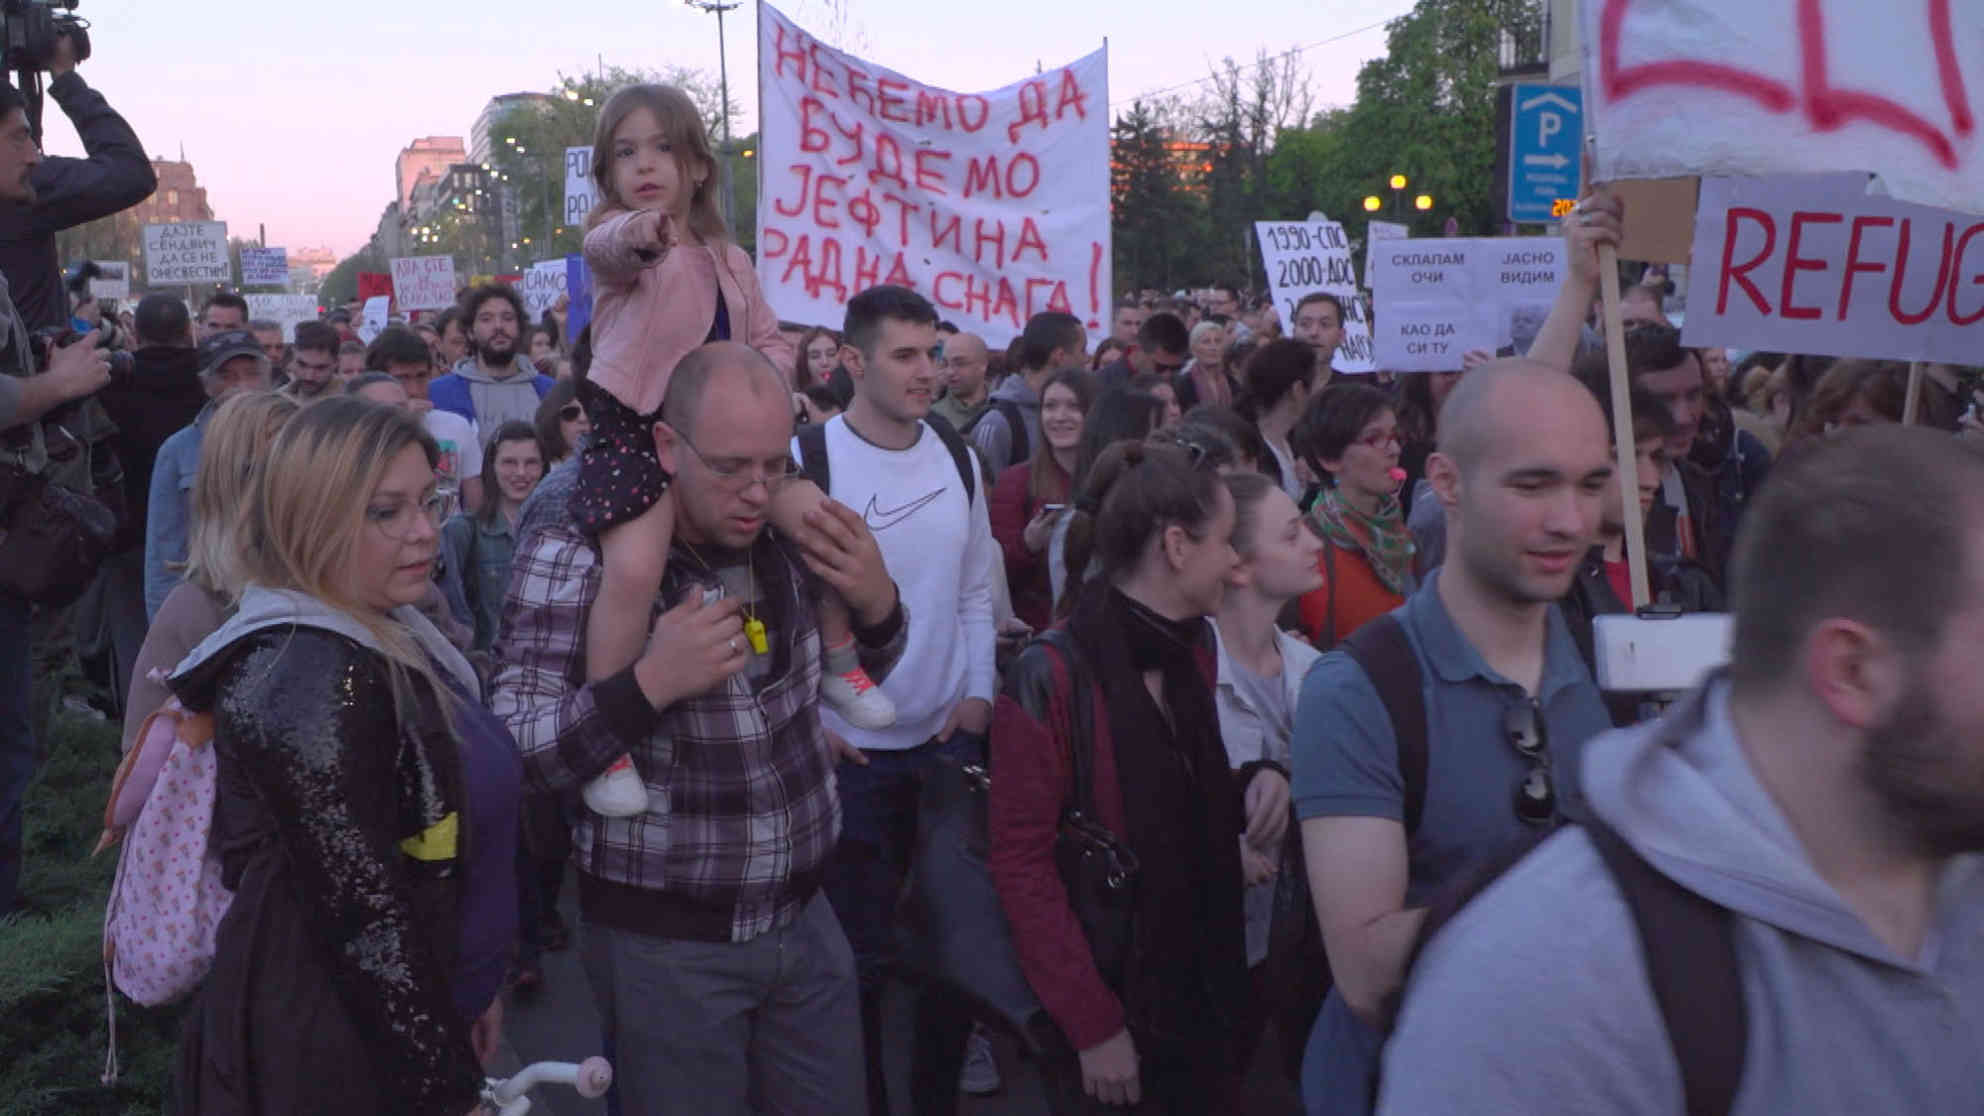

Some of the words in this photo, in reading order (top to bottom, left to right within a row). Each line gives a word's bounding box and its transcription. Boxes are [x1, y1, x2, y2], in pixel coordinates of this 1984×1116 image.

[775, 22, 990, 133] НЕЋЕМО
[1008, 67, 1088, 144] ДА
[1539, 111, 1562, 149] P
[800, 96, 1041, 199] БУДЕМО
[774, 164, 1050, 269] ЈЕФТИНА
[1391, 253, 1465, 266] СКЛАПАМ
[1501, 252, 1555, 265] ЈАСНО
[526, 270, 568, 292] САМО
[1411, 271, 1444, 284] ОЧИ
[1501, 271, 1555, 284] ВИДИМ
[1400, 323, 1431, 336] КАО
[1434, 323, 1456, 337] ДА
[1406, 342, 1428, 355] СИ
[1432, 342, 1449, 354] ТУ
